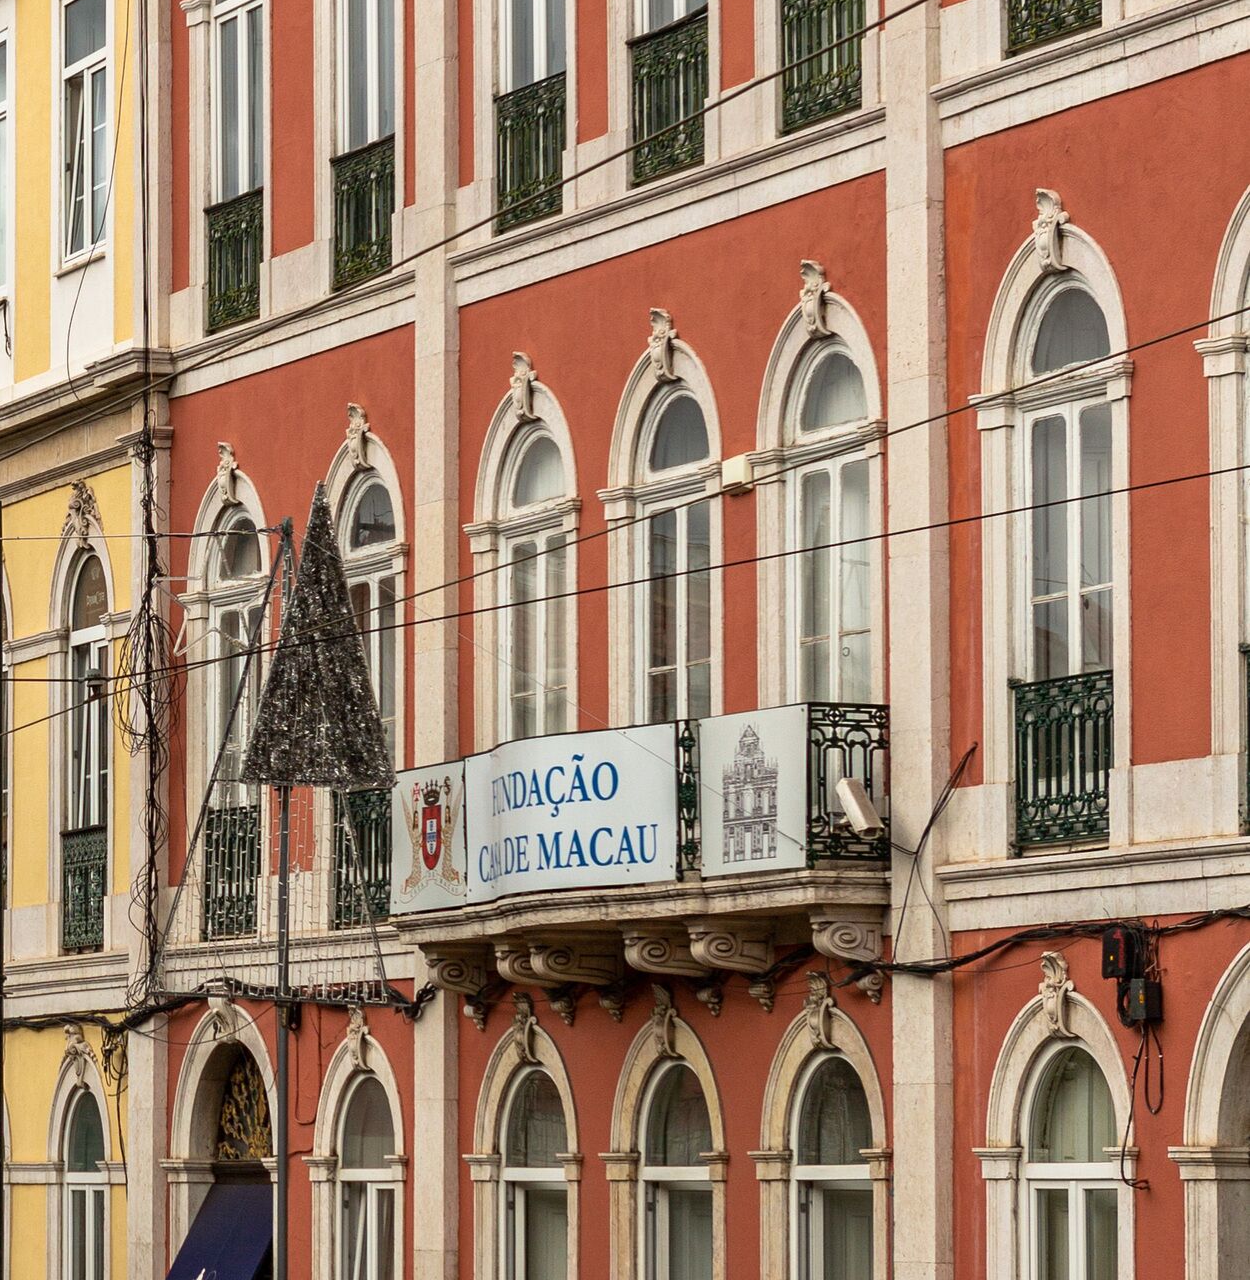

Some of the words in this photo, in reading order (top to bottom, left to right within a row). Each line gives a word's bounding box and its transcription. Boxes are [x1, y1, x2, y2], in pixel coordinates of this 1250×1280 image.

[492, 753, 619, 817] FUNDAÇÃO
[504, 834, 530, 875] DE
[536, 823, 659, 871] MACAU
